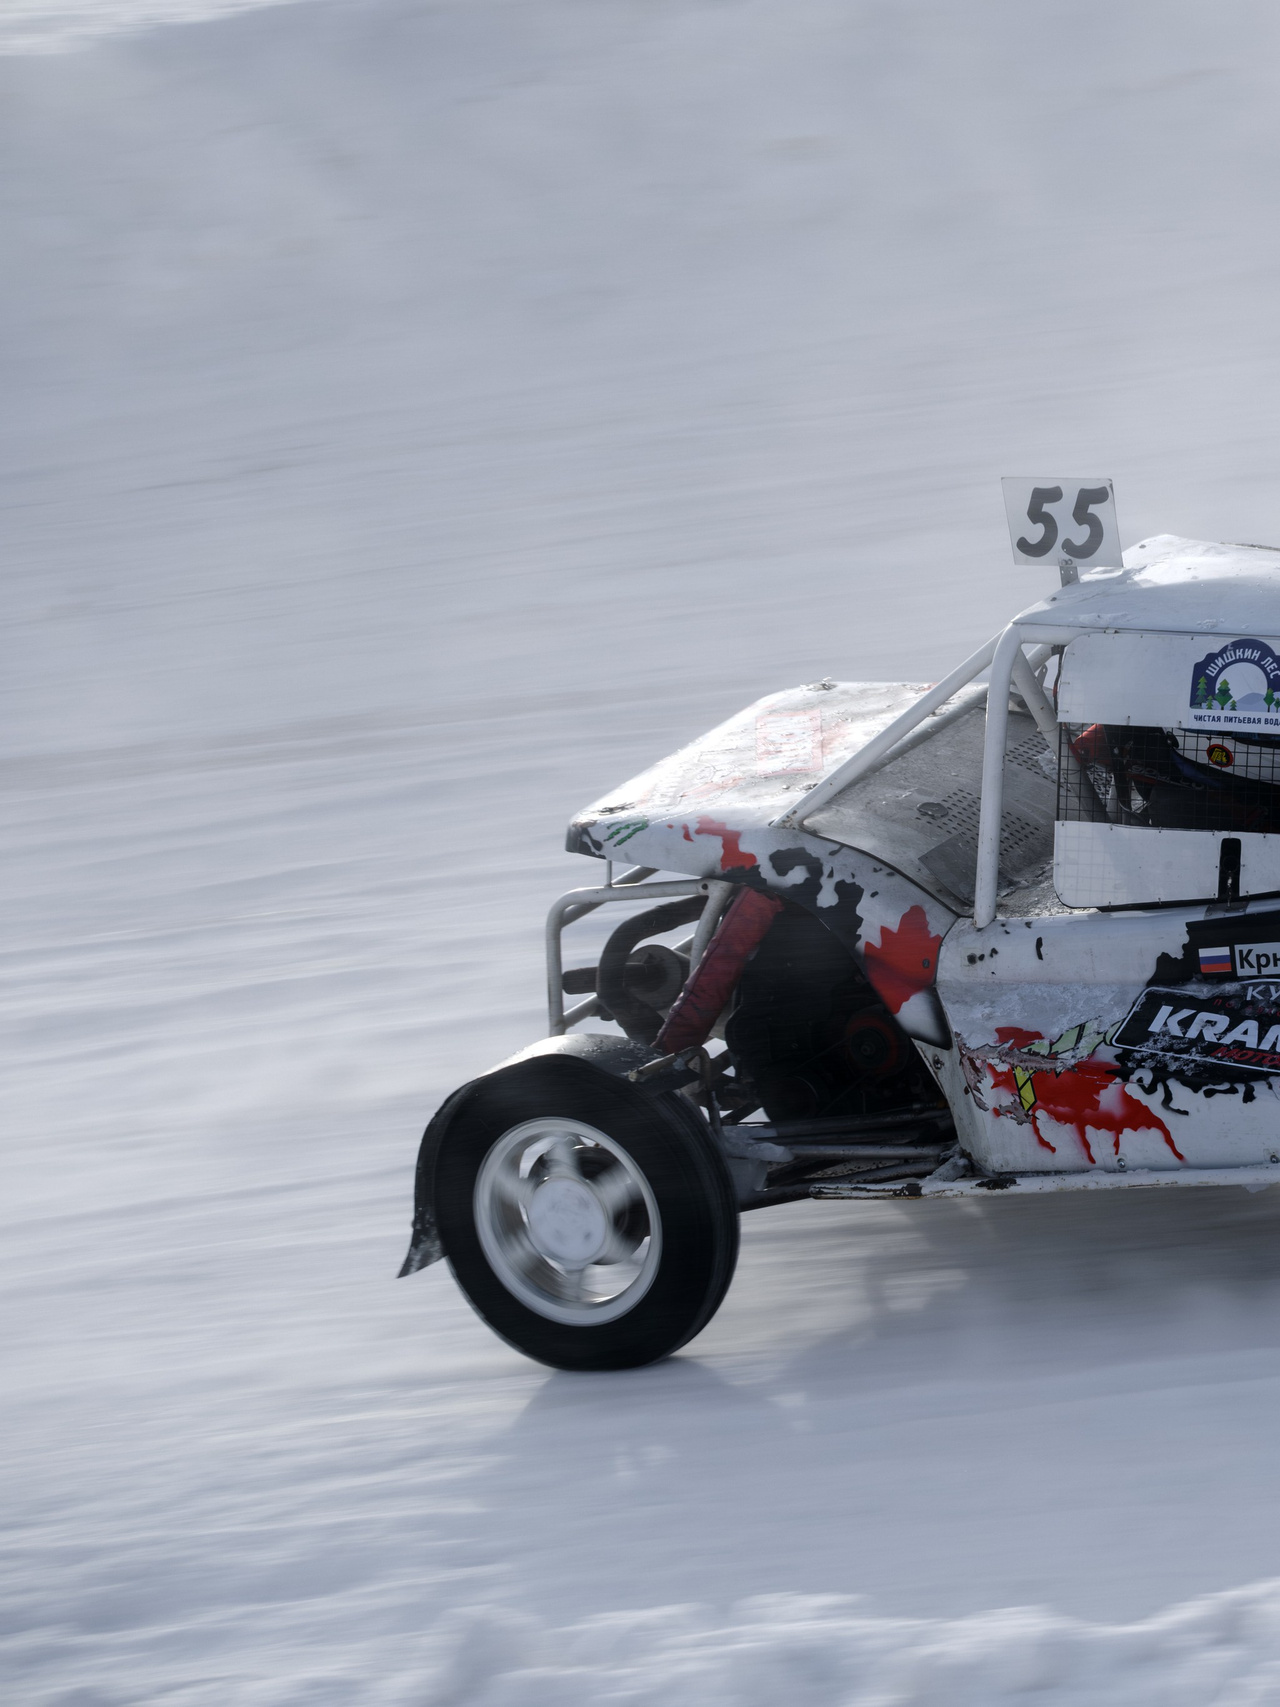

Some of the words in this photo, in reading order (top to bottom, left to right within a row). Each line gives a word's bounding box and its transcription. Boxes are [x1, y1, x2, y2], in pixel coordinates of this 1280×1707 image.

[1016, 485, 1109, 559] 55
[1205, 648, 1261, 677] ШИШКИН
[1261, 656, 1280, 679] ЛЕС
[1193, 714, 1221, 723] ЧИСТАЯ
[1223, 715, 1262, 725] ПИТЬЕВАЯ
